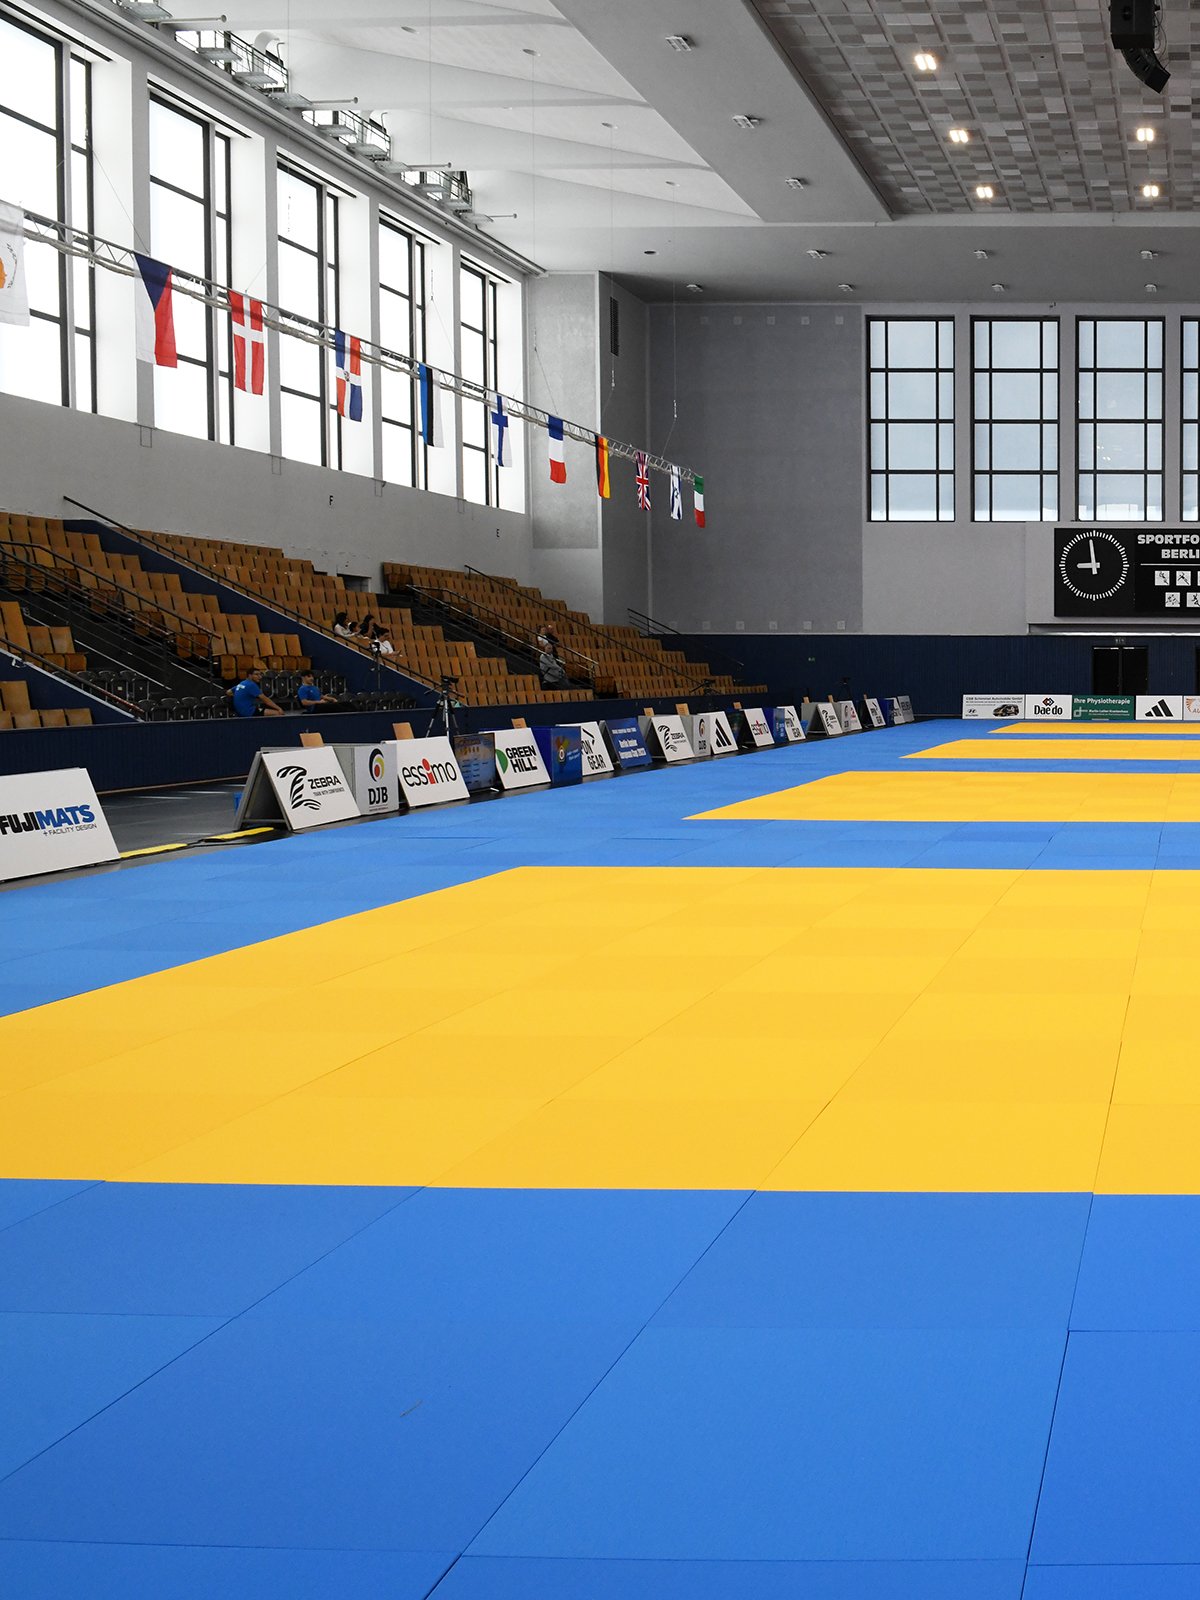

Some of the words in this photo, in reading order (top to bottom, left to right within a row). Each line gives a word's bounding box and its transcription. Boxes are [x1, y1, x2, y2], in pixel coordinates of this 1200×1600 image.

[329, 495, 334, 506] F
[496, 528, 500, 538] E
[505, 745, 536, 759] GREEN
[510, 758, 538, 774] HILL
[587, 754, 606, 770] GEAR
[402, 758, 457, 787] essimo
[308, 775, 342, 789] ZEBRA
[368, 786, 388, 805] DJB
[0, 804, 95, 835] FUJIMATS
